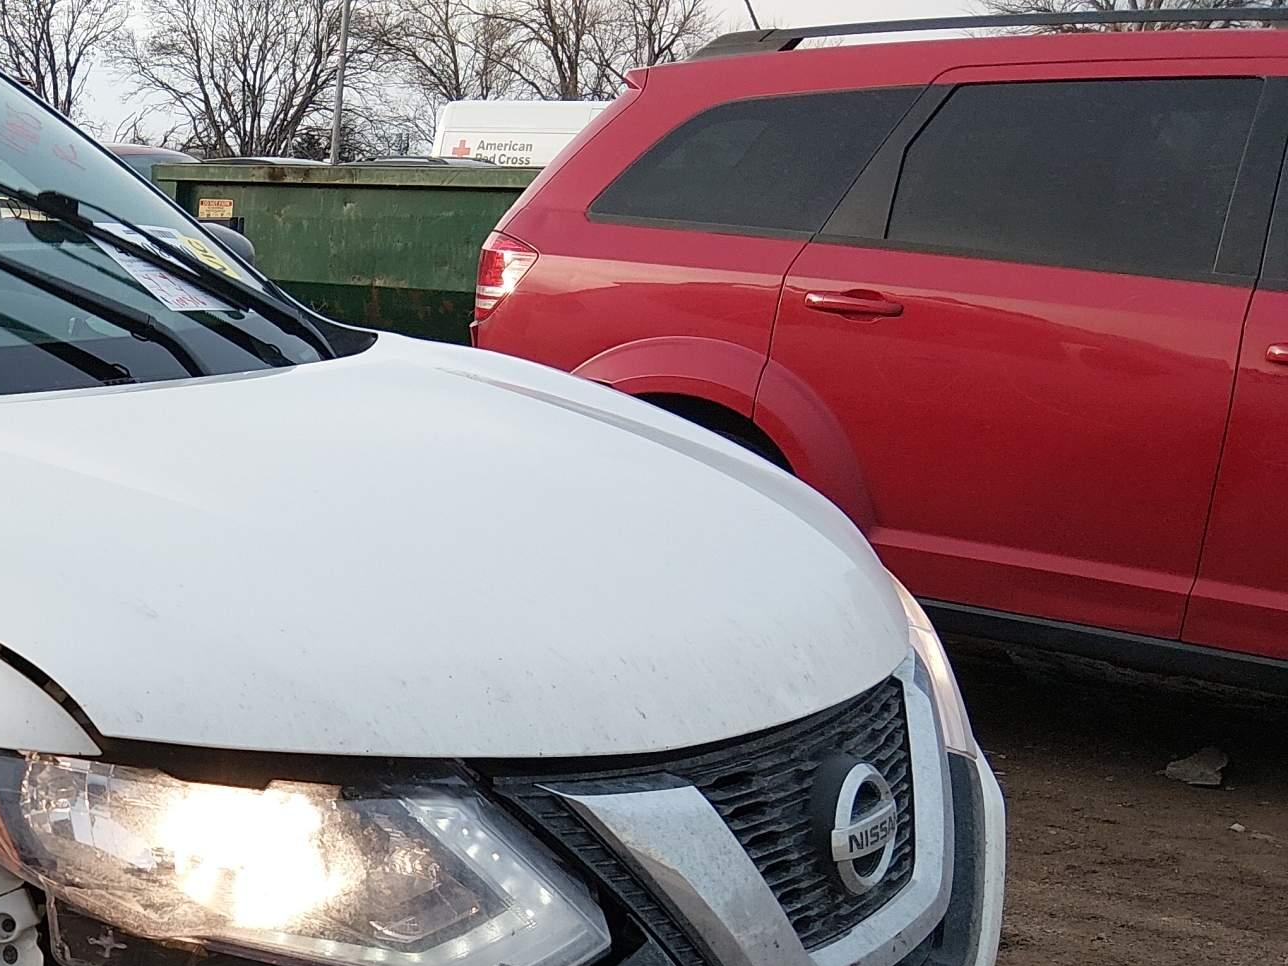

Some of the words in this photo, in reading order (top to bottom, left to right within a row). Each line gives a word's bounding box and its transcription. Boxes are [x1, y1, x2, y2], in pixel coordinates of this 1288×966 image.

[476, 139, 533, 152] American
[498, 153, 531, 165] Cross
[848, 812, 896, 853] NISSA
